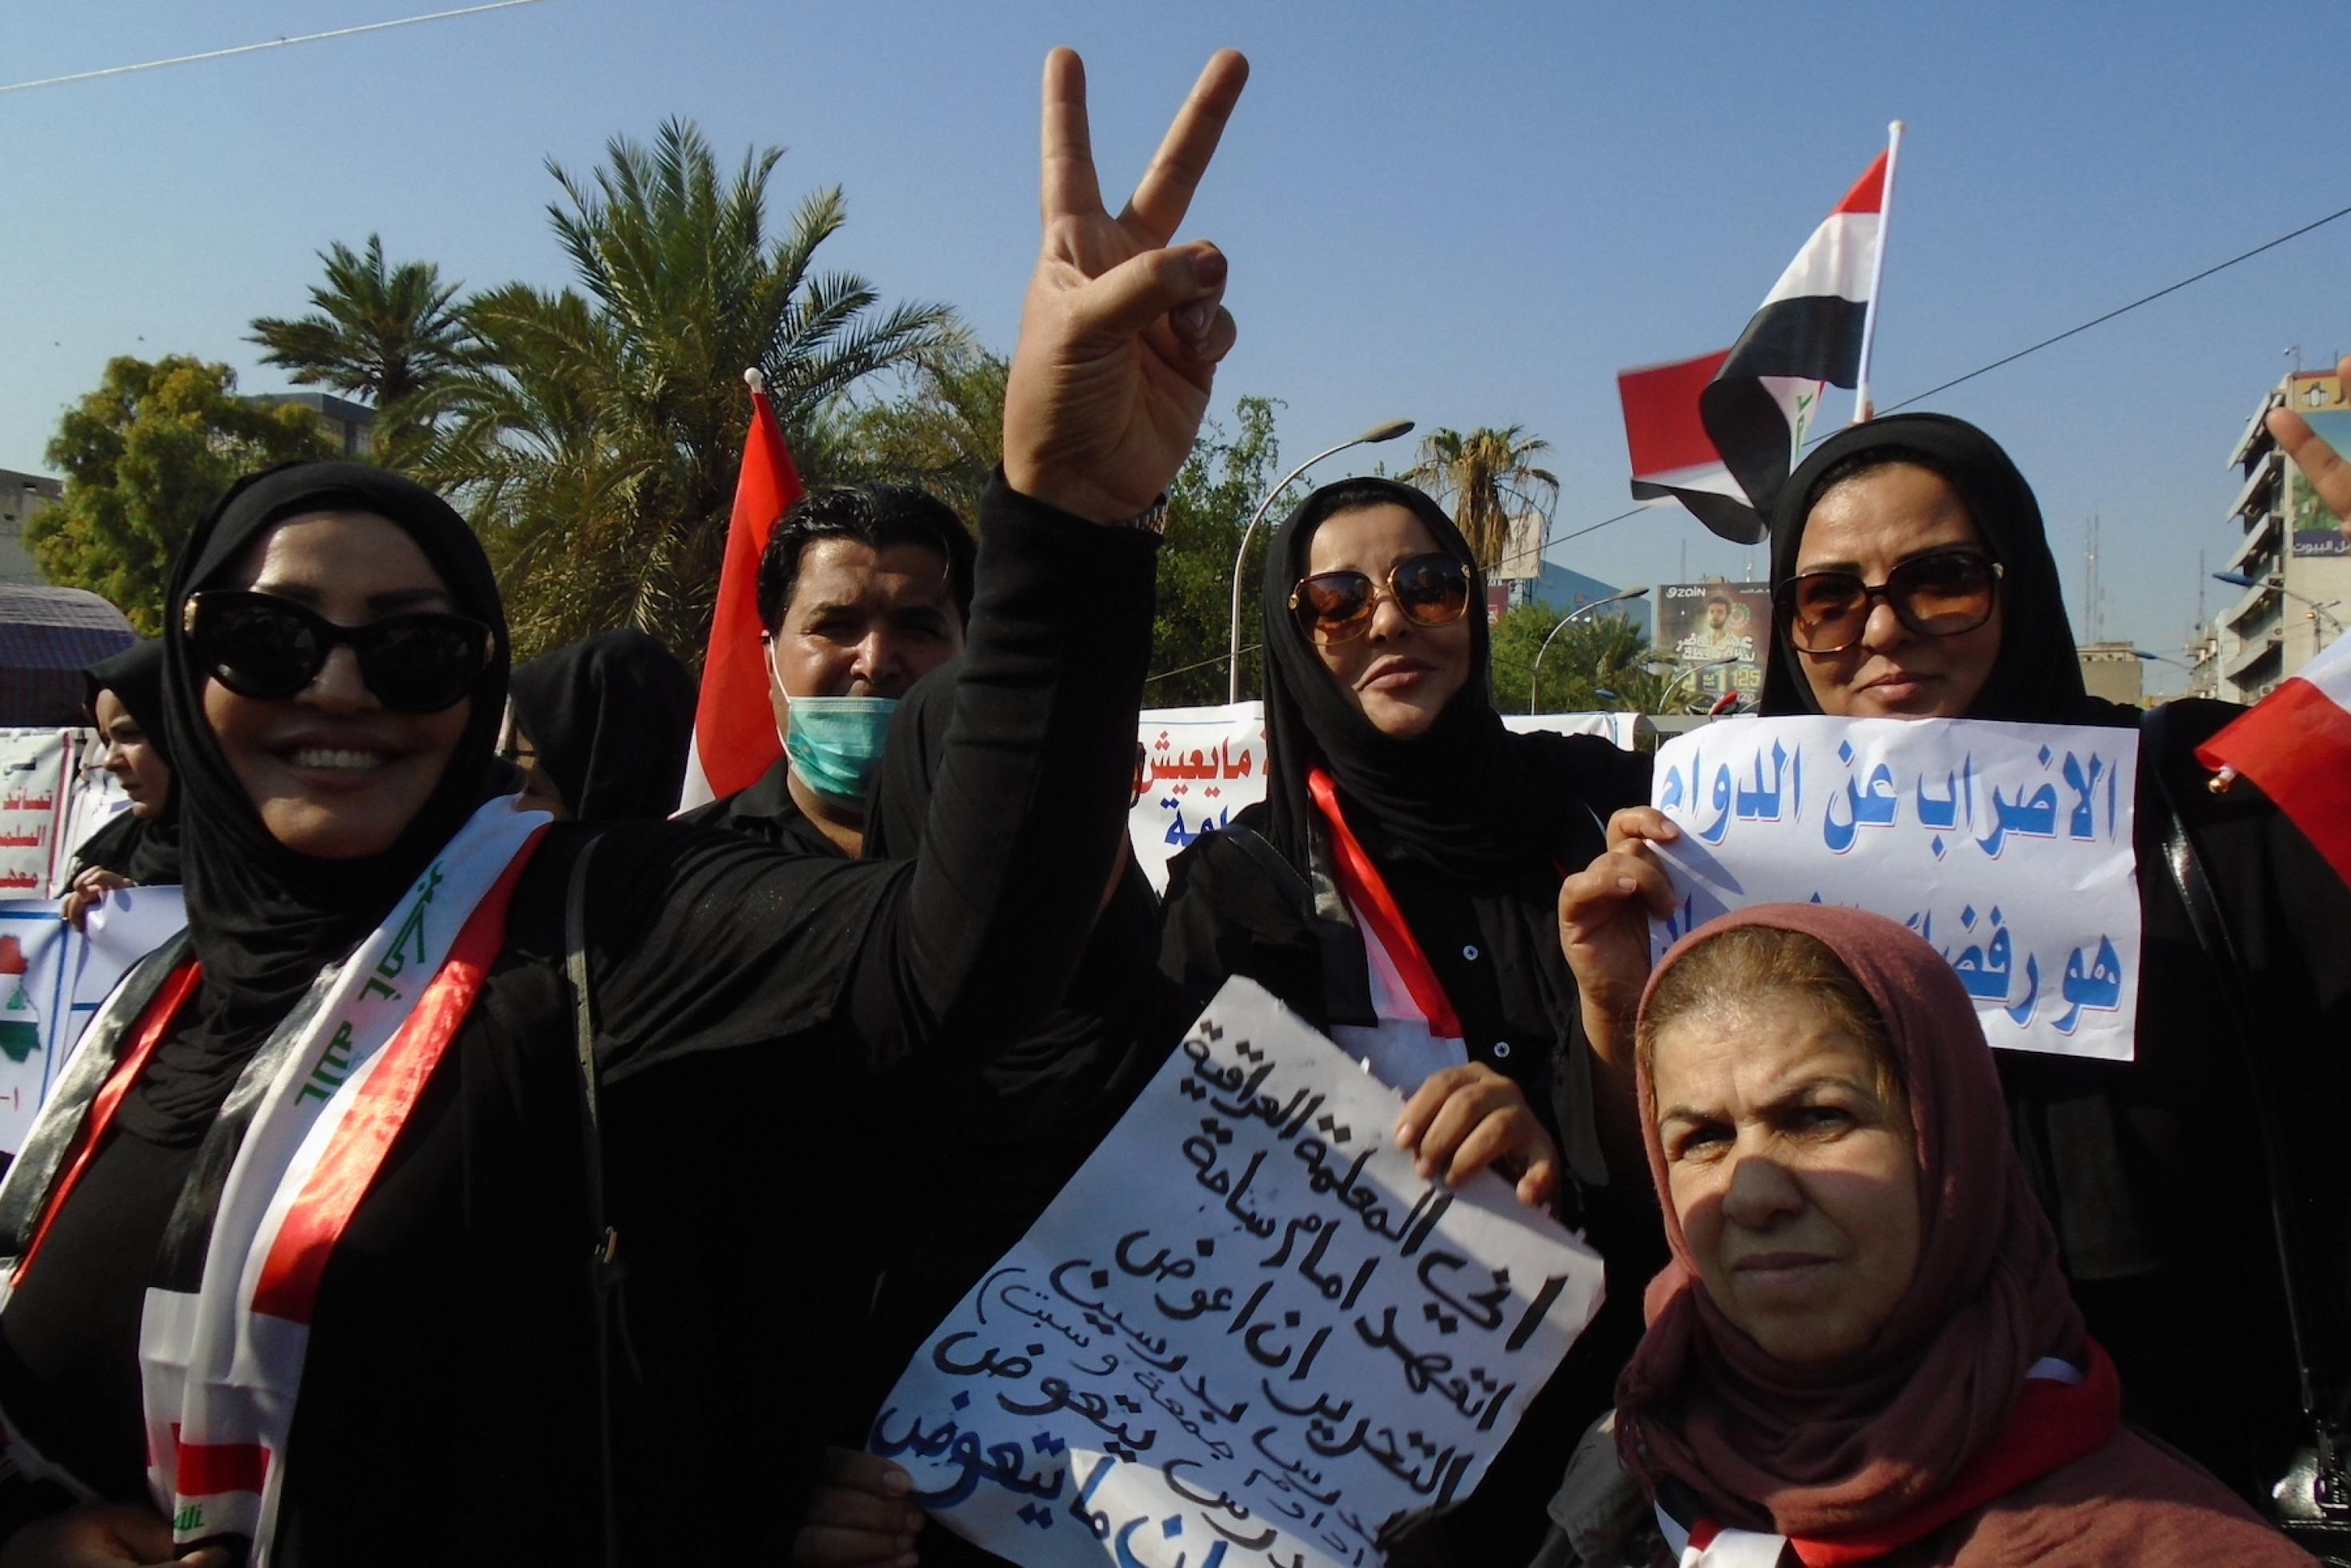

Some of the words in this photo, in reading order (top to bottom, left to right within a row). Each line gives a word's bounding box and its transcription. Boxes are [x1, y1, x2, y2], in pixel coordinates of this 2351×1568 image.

[1658, 736, 1803, 846] الدوام
[1823, 739, 1898, 853] عن
[1916, 742, 2120, 859] الاضراب
[2052, 933, 2122, 1035] هو
[1180, 1020, 1326, 1140] العراقية
[1294, 1113, 1454, 1257] المعلمة
[1354, 1306, 1518, 1431] اتعهد
[1262, 1377, 1475, 1506] التحرير
